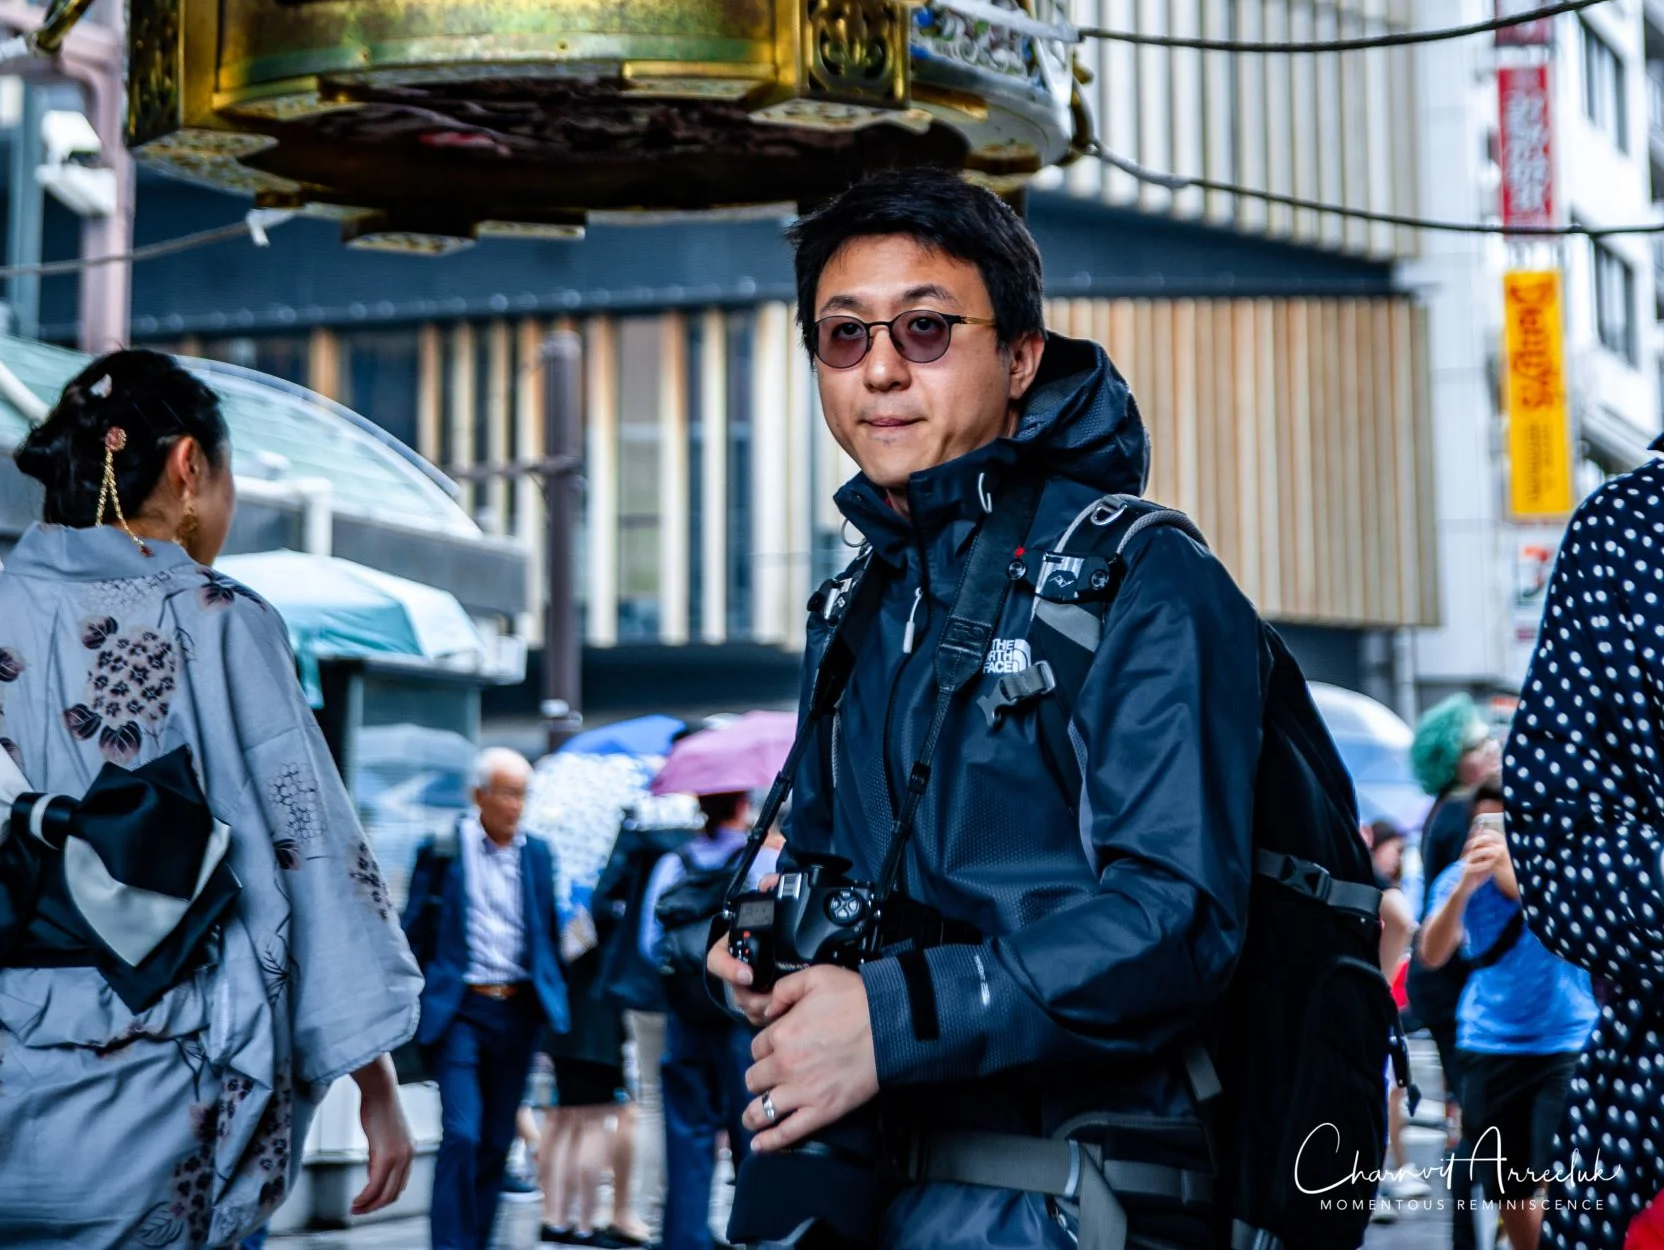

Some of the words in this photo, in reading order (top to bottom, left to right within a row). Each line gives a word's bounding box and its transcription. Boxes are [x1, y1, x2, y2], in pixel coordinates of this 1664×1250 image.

[992, 638, 1015, 650] THE
[986, 650, 1013, 662] RTH
[982, 661, 1012, 674] FACE
